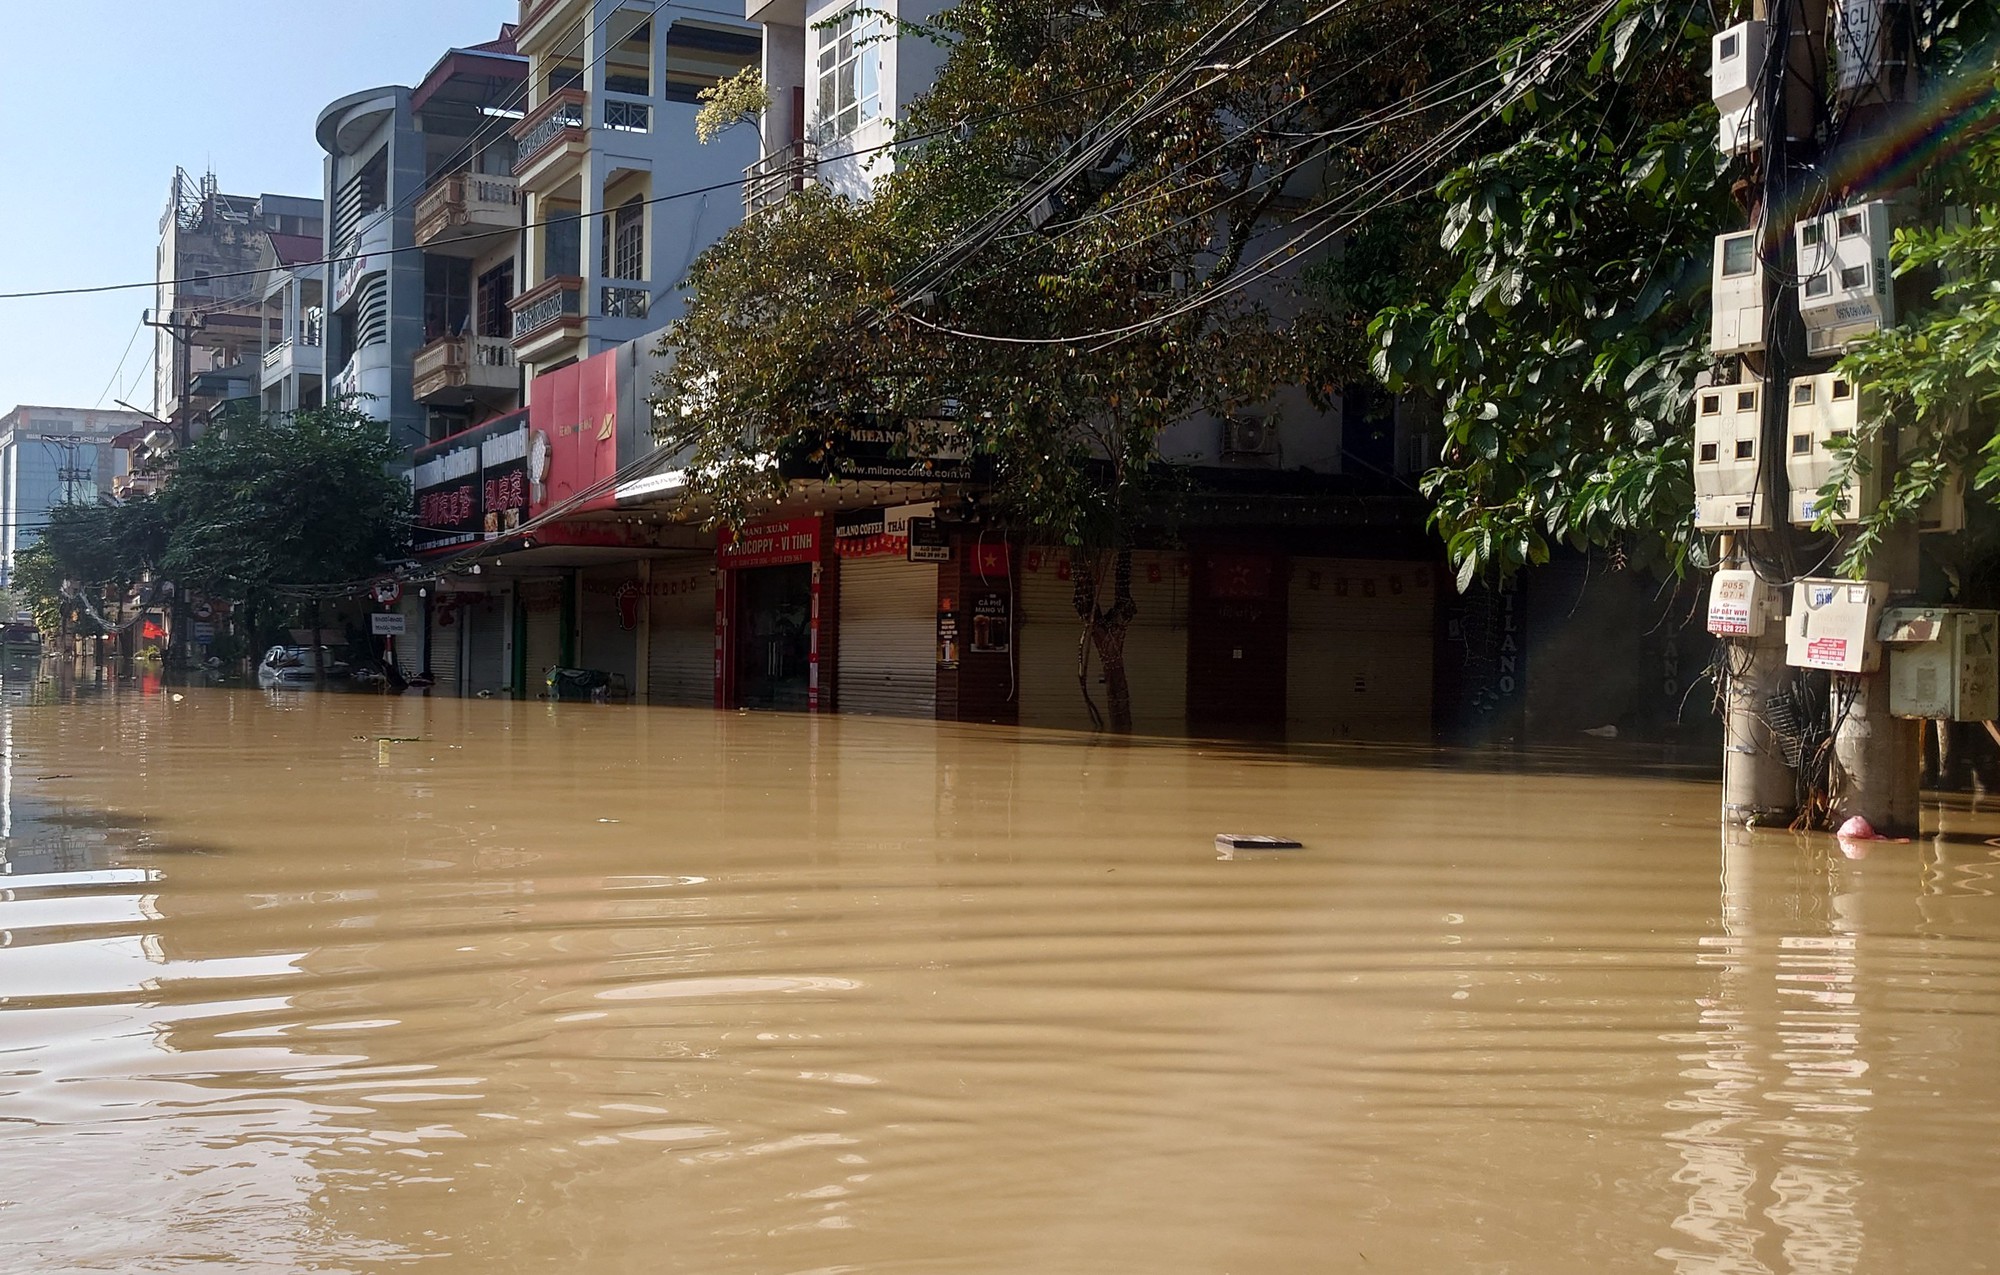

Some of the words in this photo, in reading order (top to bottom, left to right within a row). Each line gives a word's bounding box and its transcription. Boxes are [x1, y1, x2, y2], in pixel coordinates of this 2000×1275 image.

[766, 522, 789, 534] XUÂN
[836, 524, 859, 537] MILANO
[859, 521, 883, 535] COFFEE
[887, 518, 906, 533] THÁI
[781, 536, 790, 551] VI
[792, 531, 812, 550] TÍNH
[1710, 606, 1721, 615] LẮP
[1721, 607, 1732, 616] ĐẶT
[1733, 609, 1748, 617] WIFI
[1735, 625, 1747, 633] 222
